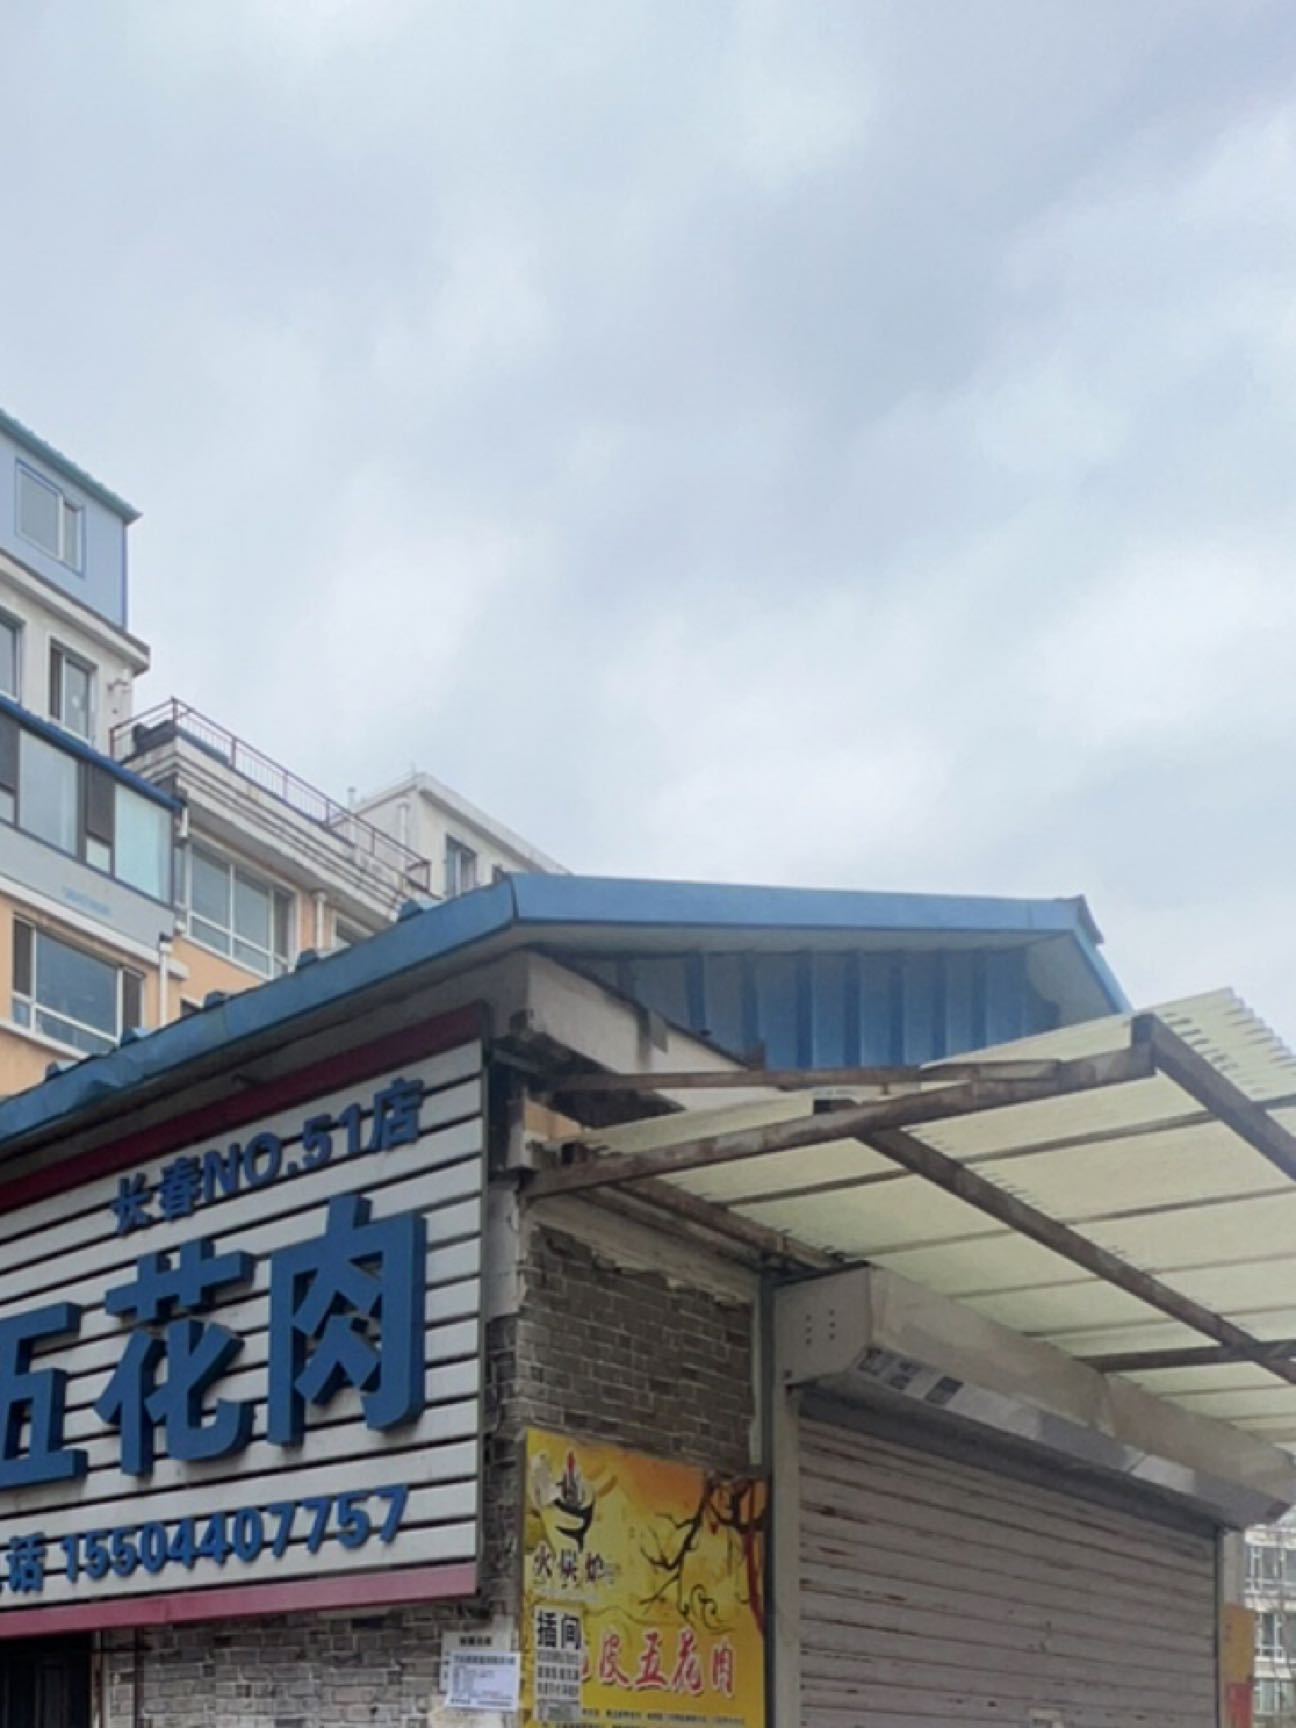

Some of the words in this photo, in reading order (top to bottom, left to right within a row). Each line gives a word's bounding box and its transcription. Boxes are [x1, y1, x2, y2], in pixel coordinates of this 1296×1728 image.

[109, 1077, 425, 1238] 长春NO.51店
[60, 1483, 409, 1584] 15504407757
[537, 1609, 581, 1649] 插间
[581, 1626, 735, 1698] 皮五花肉
